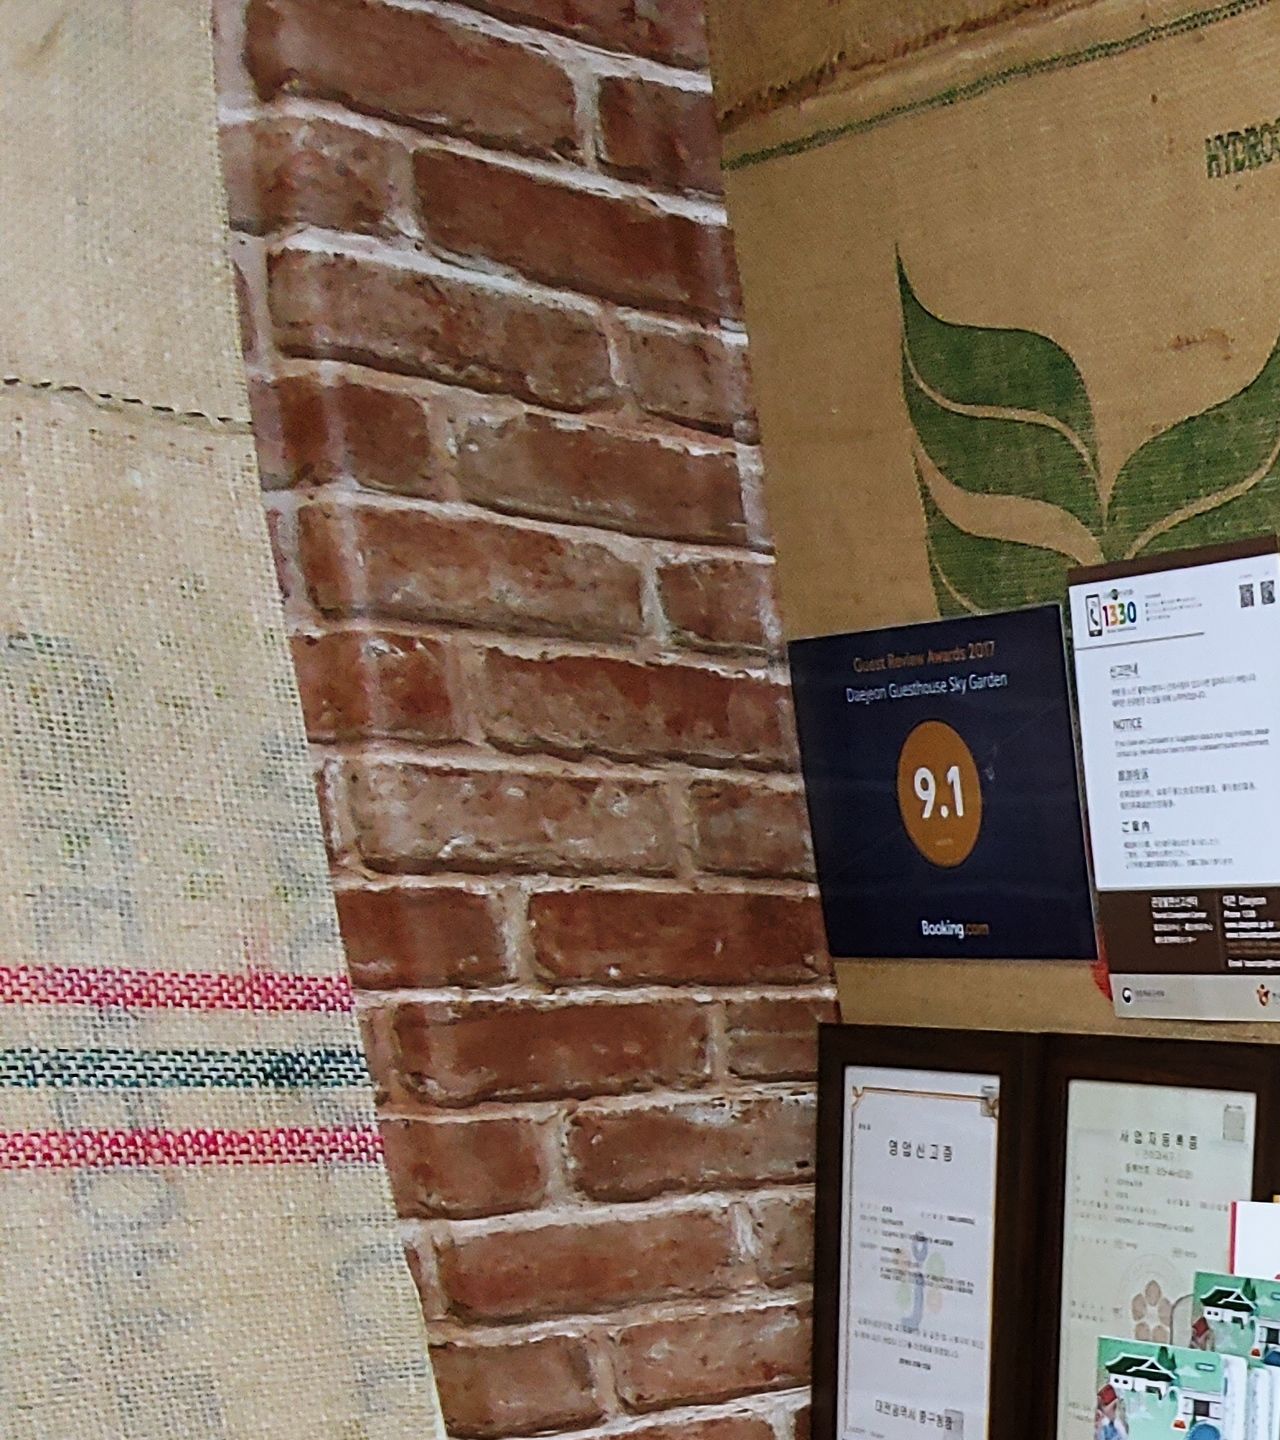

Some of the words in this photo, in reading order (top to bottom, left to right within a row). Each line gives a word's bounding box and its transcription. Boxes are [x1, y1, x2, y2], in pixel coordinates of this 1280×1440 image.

[1102, 601, 1137, 627] 1330
[927, 646, 966, 665] Awards
[968, 640, 996, 660] 2017
[846, 686, 887, 705] Daejeon
[888, 679, 948, 699] Guesthouse
[949, 675, 967, 695] Sky
[968, 671, 1008, 691] Garden
[1113, 717, 1142, 732] NOTICE
[913, 765, 964, 819] 9.1
